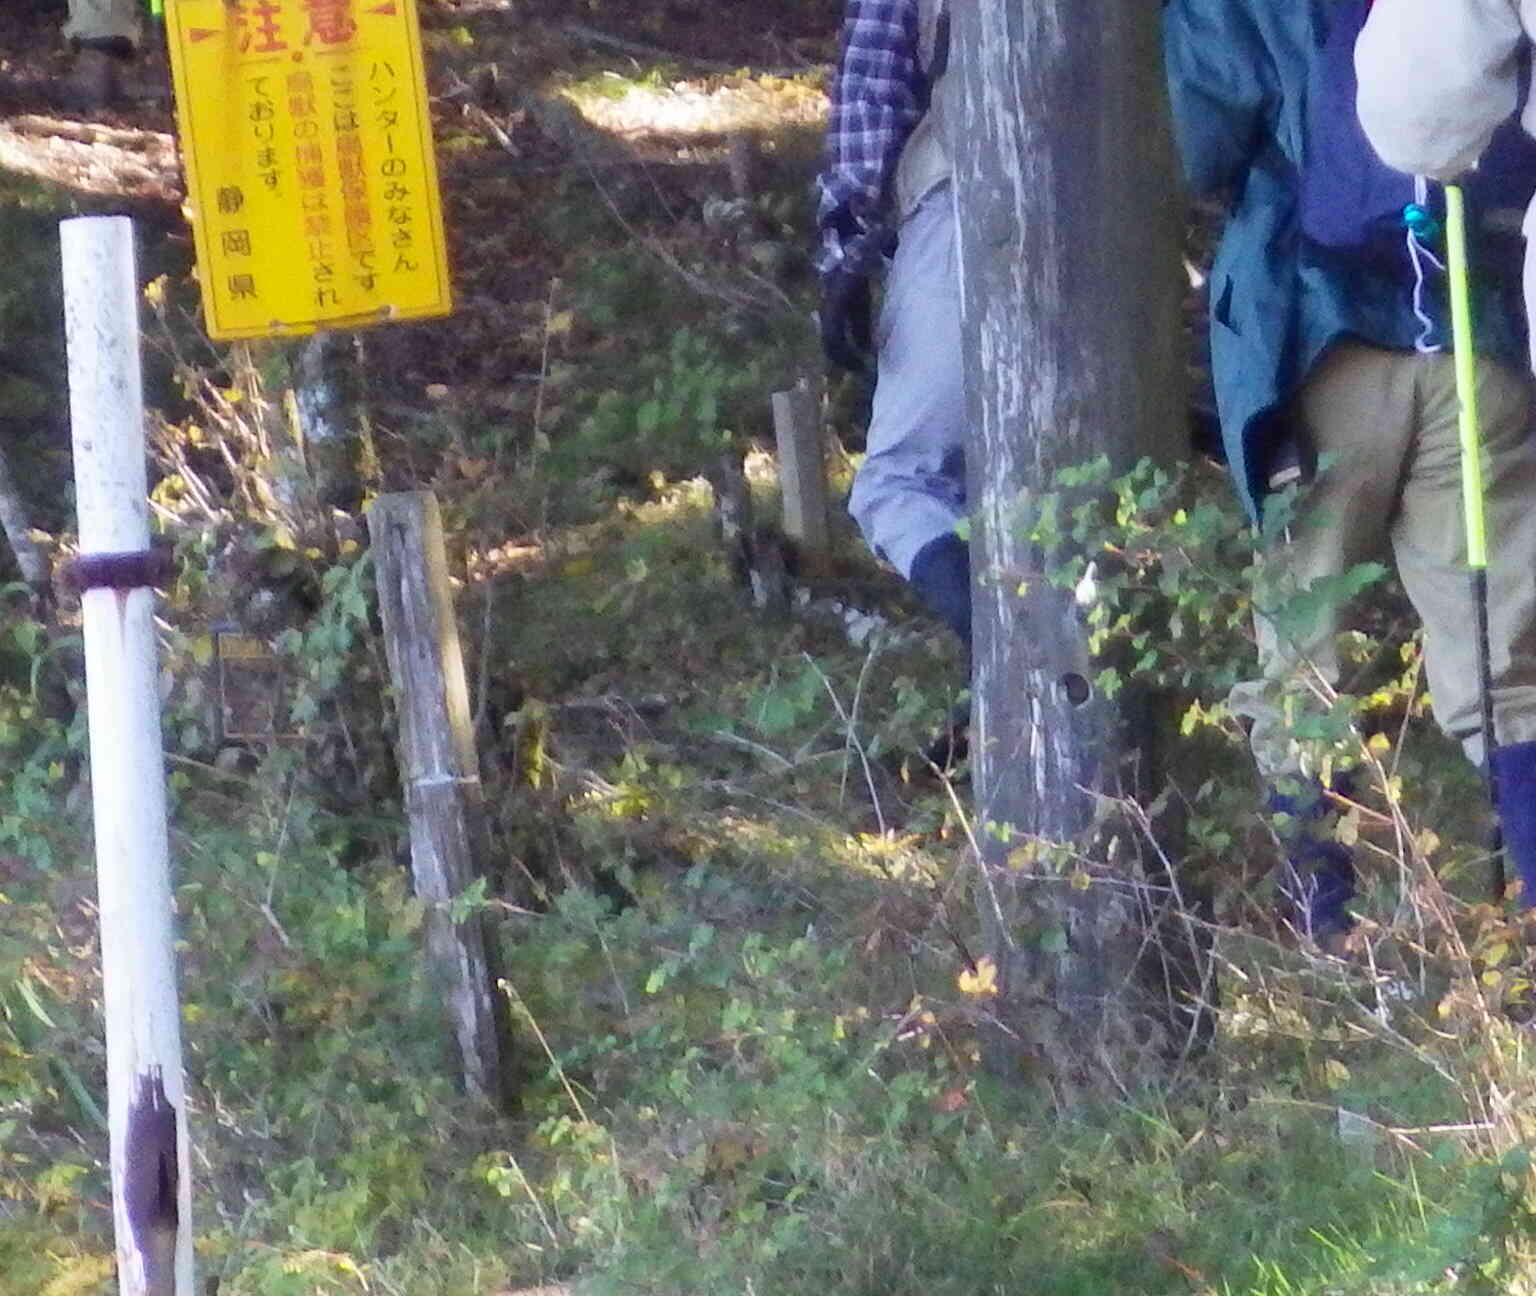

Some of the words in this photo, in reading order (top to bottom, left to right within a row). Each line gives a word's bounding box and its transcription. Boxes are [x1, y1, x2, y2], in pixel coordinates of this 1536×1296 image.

[216, 185, 259, 302] 静岡県
[370, 62, 418, 274] ハンターのみなさん
